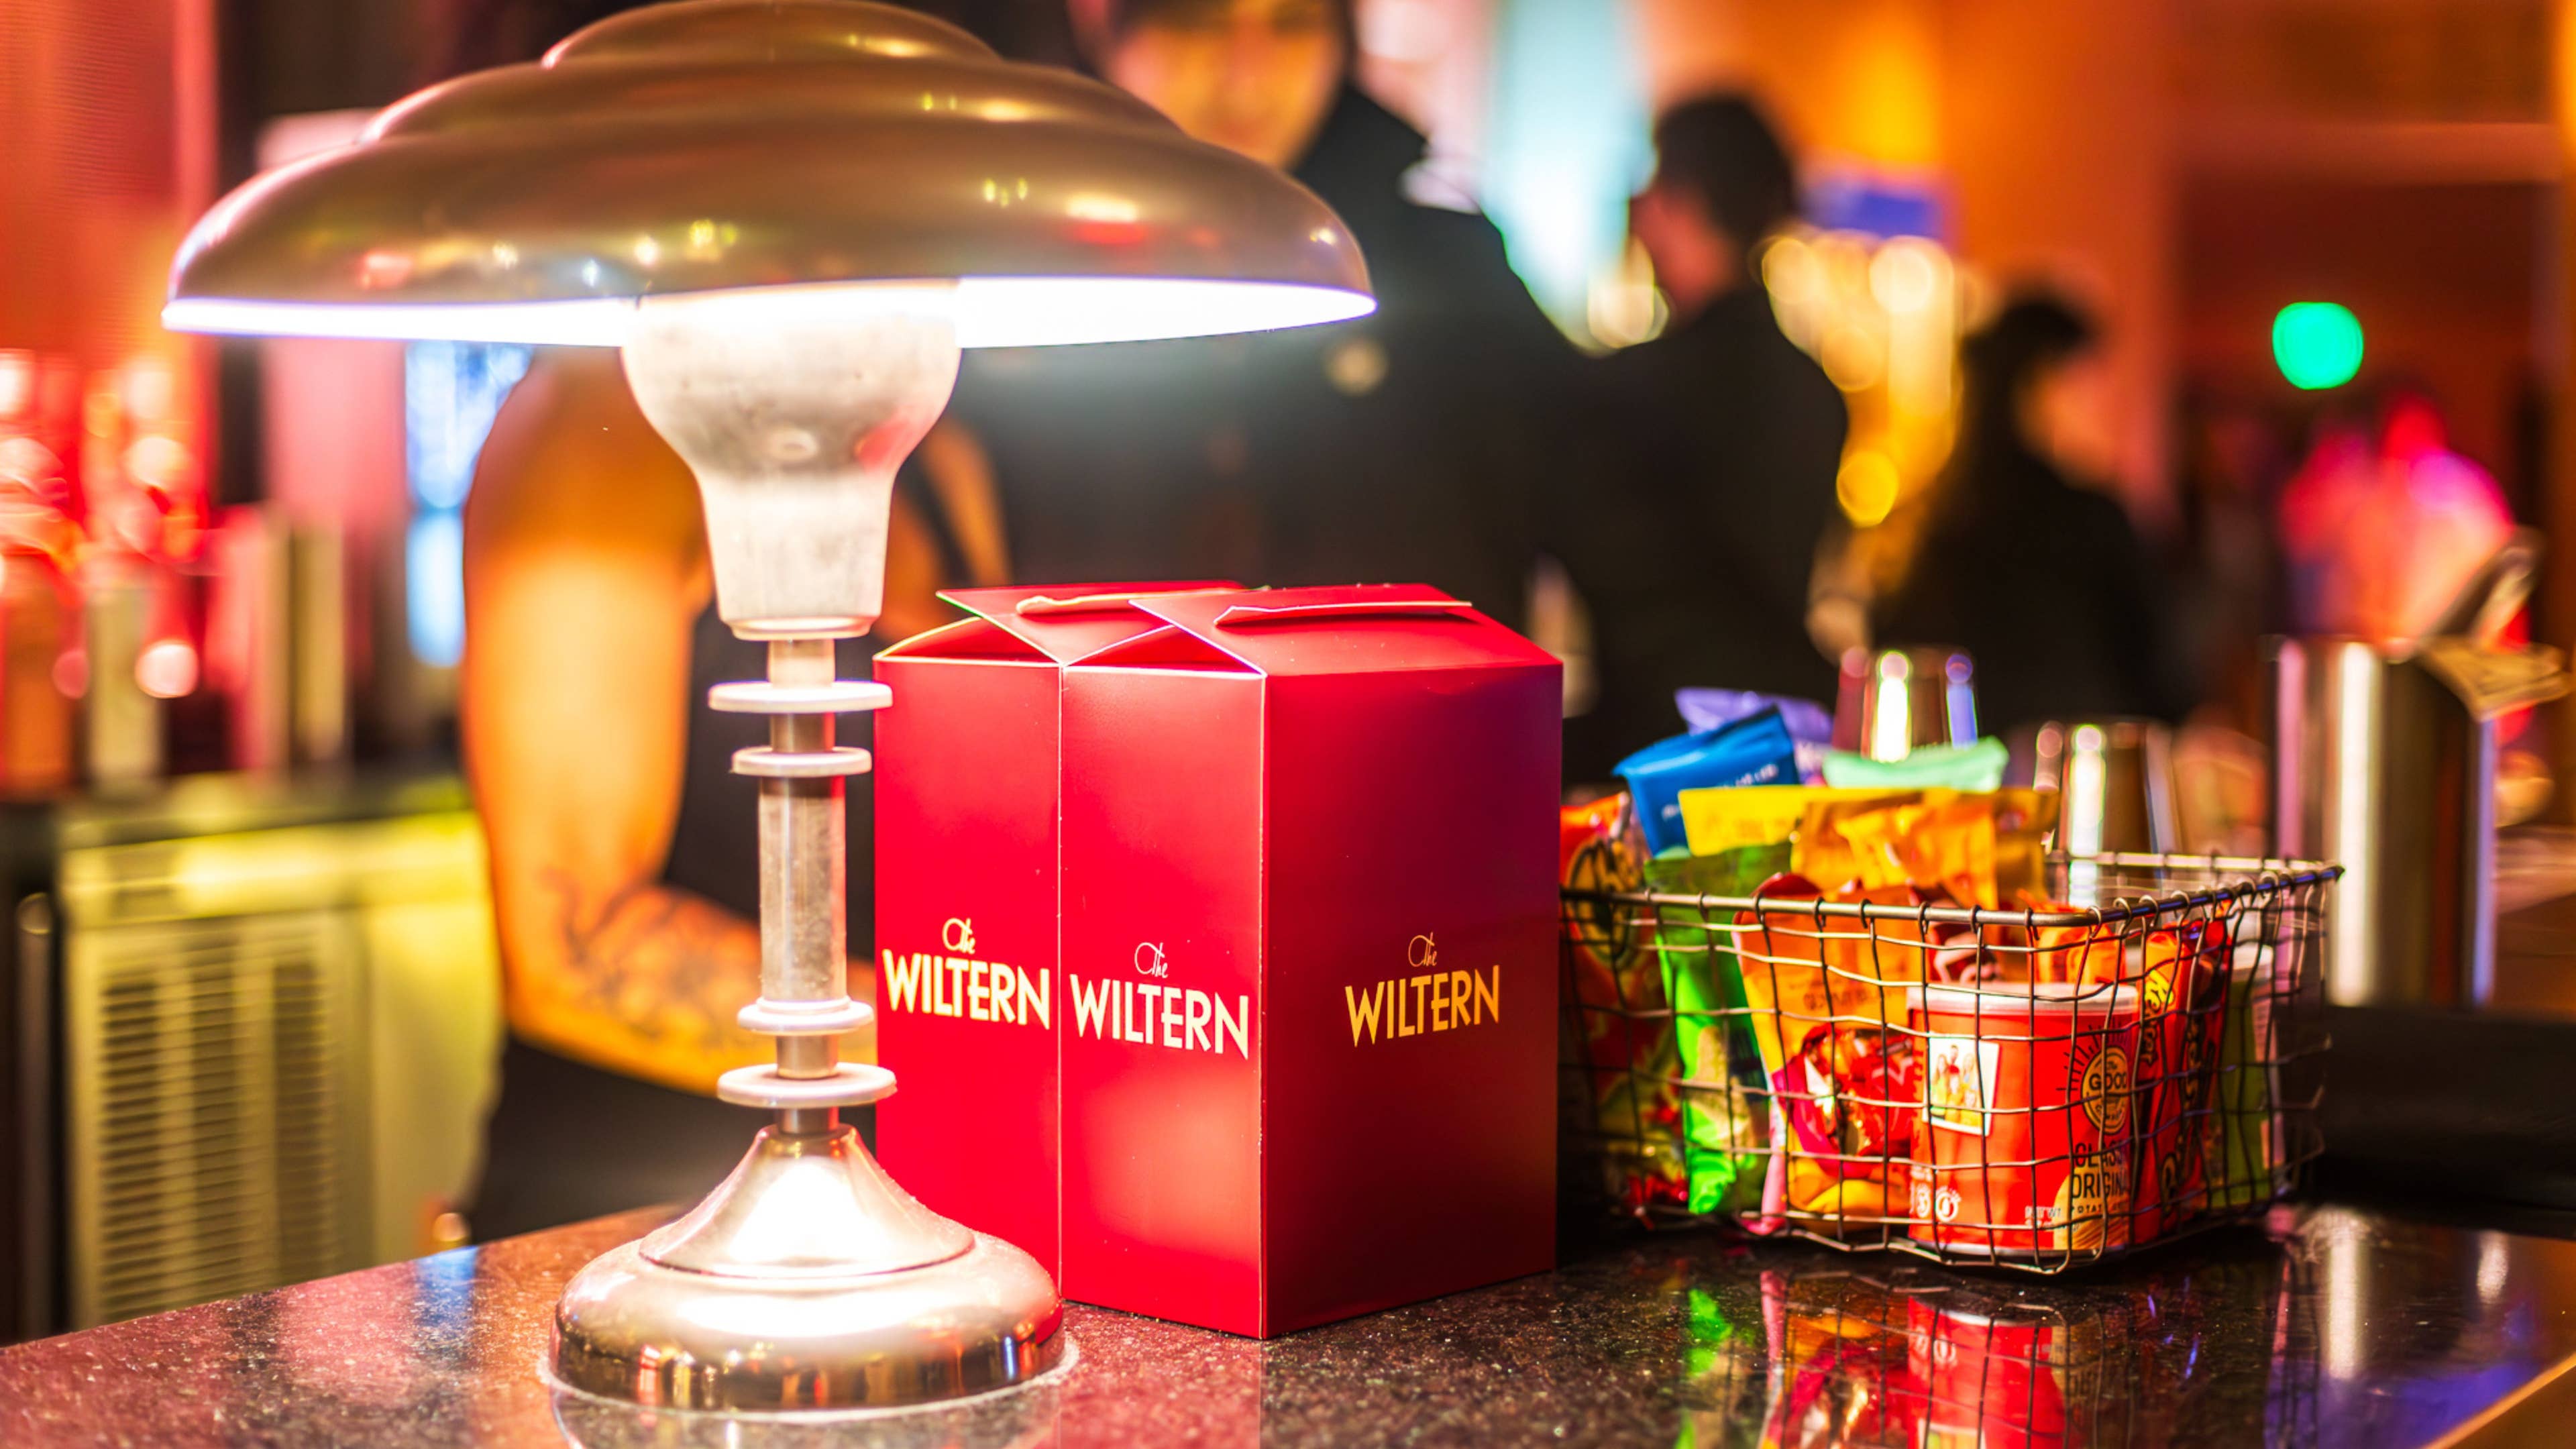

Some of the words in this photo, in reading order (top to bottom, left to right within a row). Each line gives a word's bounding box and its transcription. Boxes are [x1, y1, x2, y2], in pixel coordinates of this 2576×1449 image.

[942, 918, 976, 955] The
[1134, 942, 1169, 978] The
[1408, 932, 1437, 967] The
[882, 949, 1050, 1030] WILTERN
[1069, 973, 1248, 1061] WILTERN
[1344, 965, 1500, 1048] WILTERN
